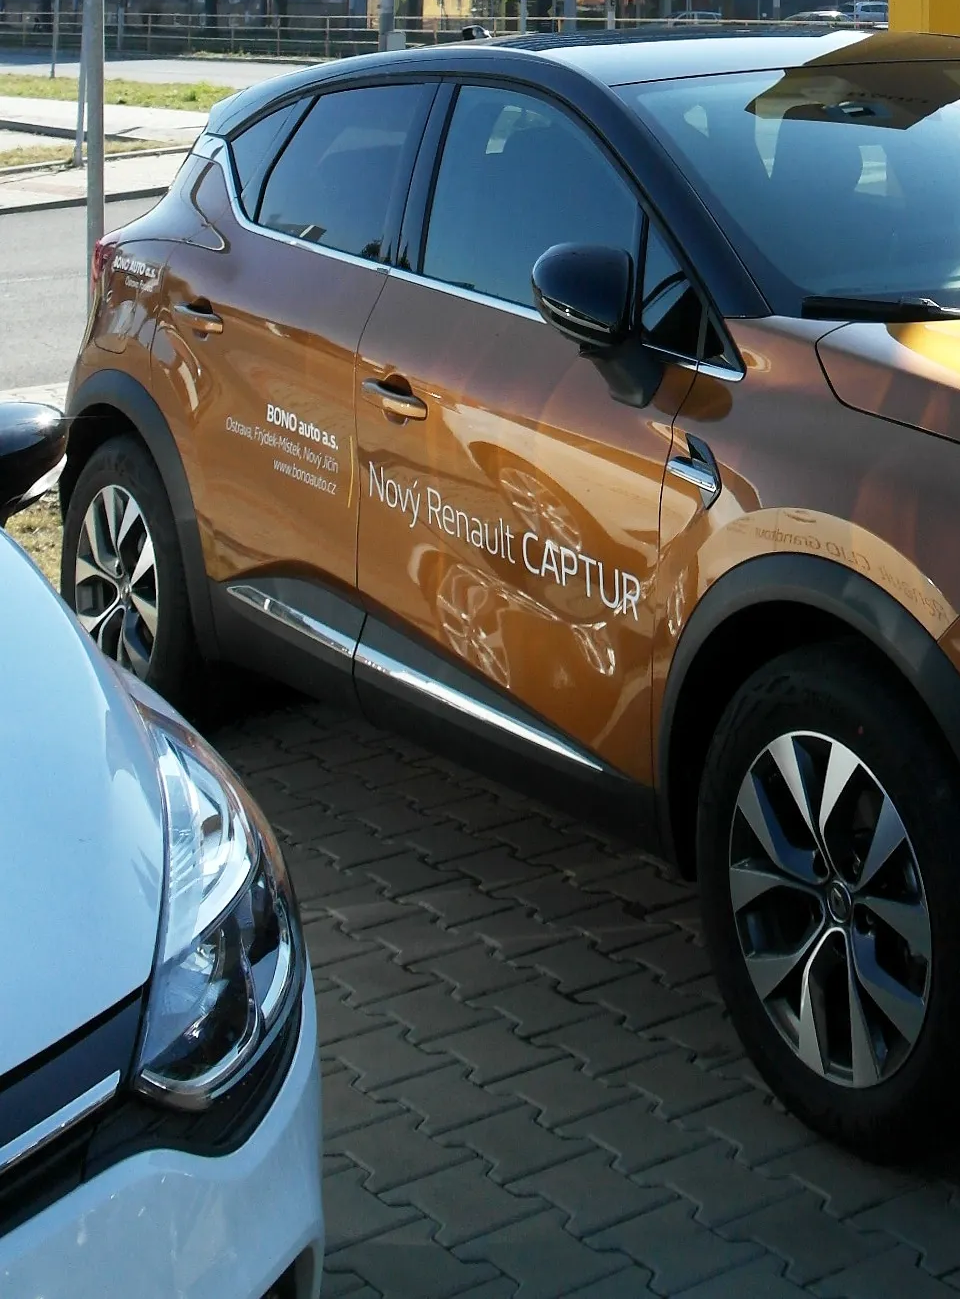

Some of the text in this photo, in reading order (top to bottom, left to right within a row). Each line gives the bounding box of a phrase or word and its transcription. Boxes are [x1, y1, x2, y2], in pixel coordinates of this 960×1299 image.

[225, 416, 254, 440] Ostrava,
[253, 426, 302, 460] Frýdek-Místek,
[302, 446, 322, 469] Nový
[266, 403, 339, 451] BONO auto a.s.
[273, 459, 337, 496] www.bonoauto.cz
[368, 460, 642, 622] Nový Renault CAPTUR
